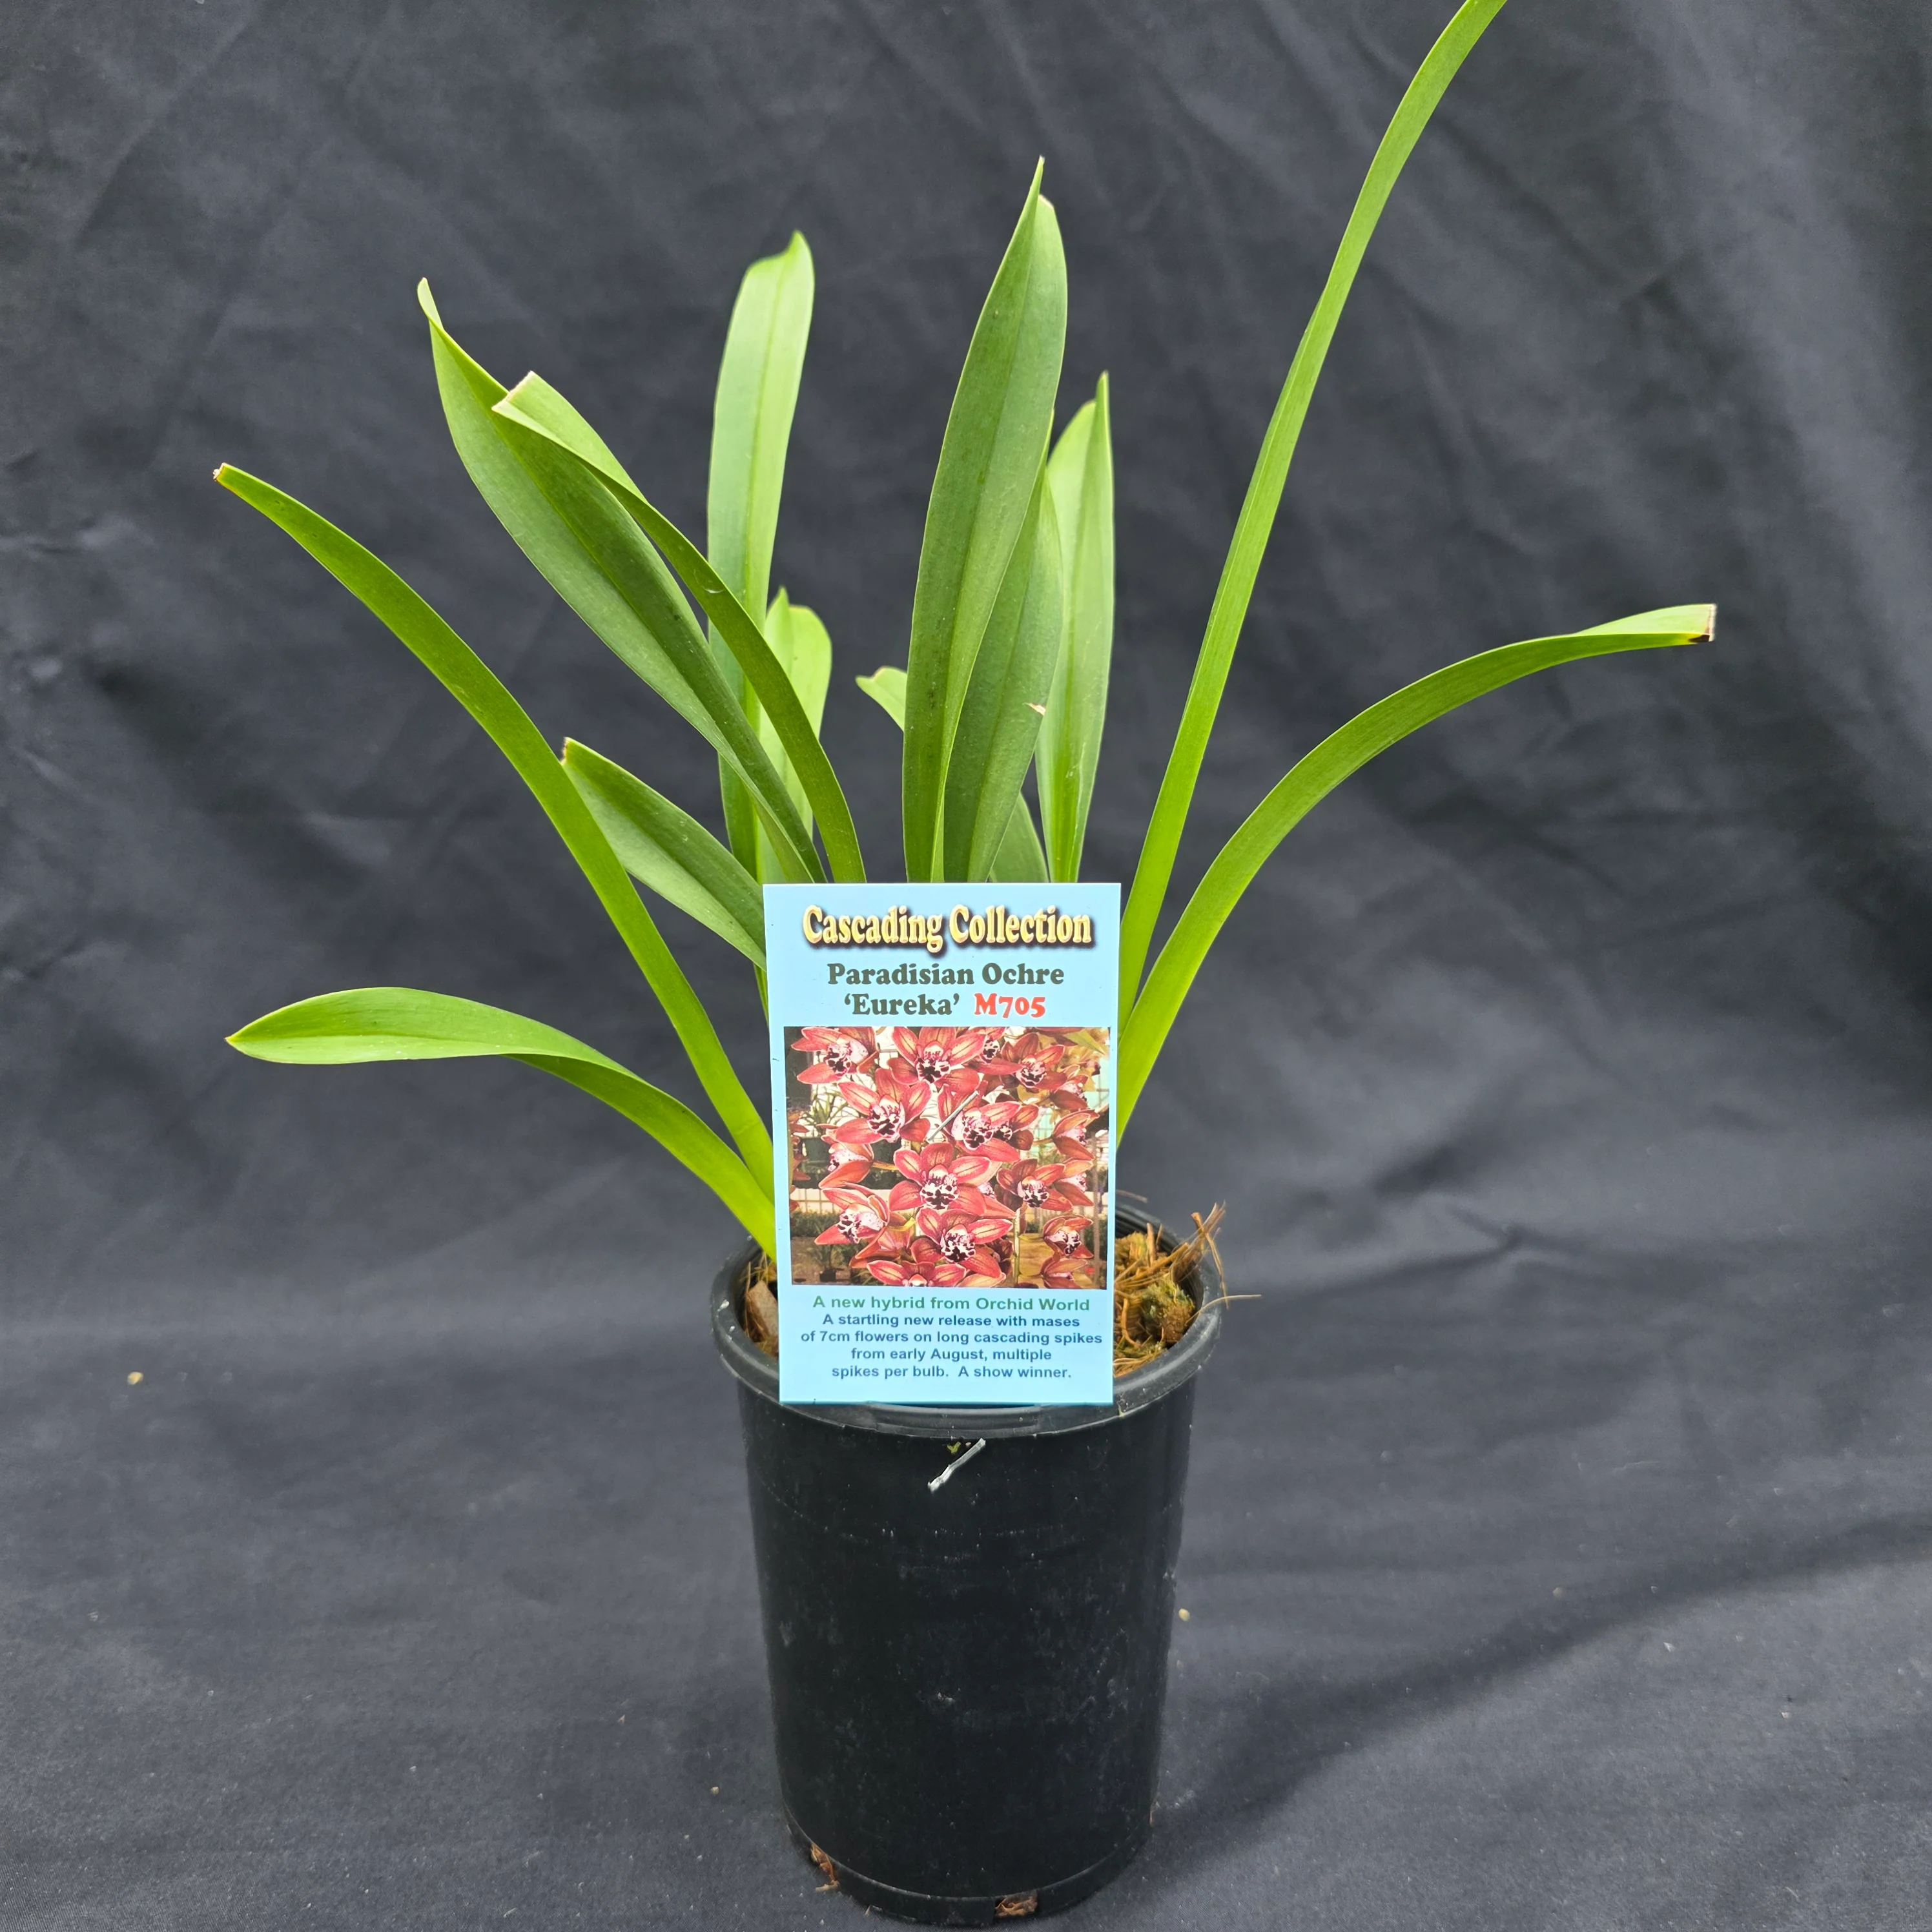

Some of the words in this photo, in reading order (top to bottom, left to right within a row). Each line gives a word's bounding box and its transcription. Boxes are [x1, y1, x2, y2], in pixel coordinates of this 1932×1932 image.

[802, 905, 943, 952] Cascading
[949, 905, 1092, 943] Collection
[827, 963, 975, 985] Paradisian
[981, 962, 1065, 985] Ochre
[974, 992, 1046, 1019] M705
[812, 1295, 826, 1308] A
[831, 1299, 866, 1308] new
[871, 1296, 925, 1311] hybrid
[930, 1297, 970, 1310] from
[976, 1297, 1033, 1310] Orchid
[1038, 1298, 1089, 1311] World
[822, 1313, 834, 1325] A
[838, 1313, 899, 1328] startling
[904, 1317, 934, 1326] new
[938, 1315, 992, 1326] release
[996, 1315, 1027, 1326] with
[1032, 1318, 1080, 1327] mases
[801, 1330, 816, 1342] of
[819, 1330, 850, 1342] 7cm
[854, 1330, 909, 1342] flowers
[913, 1333, 932, 1342] on
[937, 1331, 969, 1345] long
[974, 1331, 1049, 1346] cascading
[1054, 1332, 1102, 1346] spikes
[850, 1347, 885, 1359] from
[890, 1348, 926, 1362] early
[930, 1348, 987, 1362] August,
[992, 1348, 1052, 1363] multiple
[832, 1365, 879, 1380] spikes
[884, 1368, 909, 1380] per
[912, 1365, 949, 1377] bulb.
[958, 1366, 969, 1377] A
[974, 1366, 1013, 1378] show
[1017, 1366, 1071, 1378] winner.
